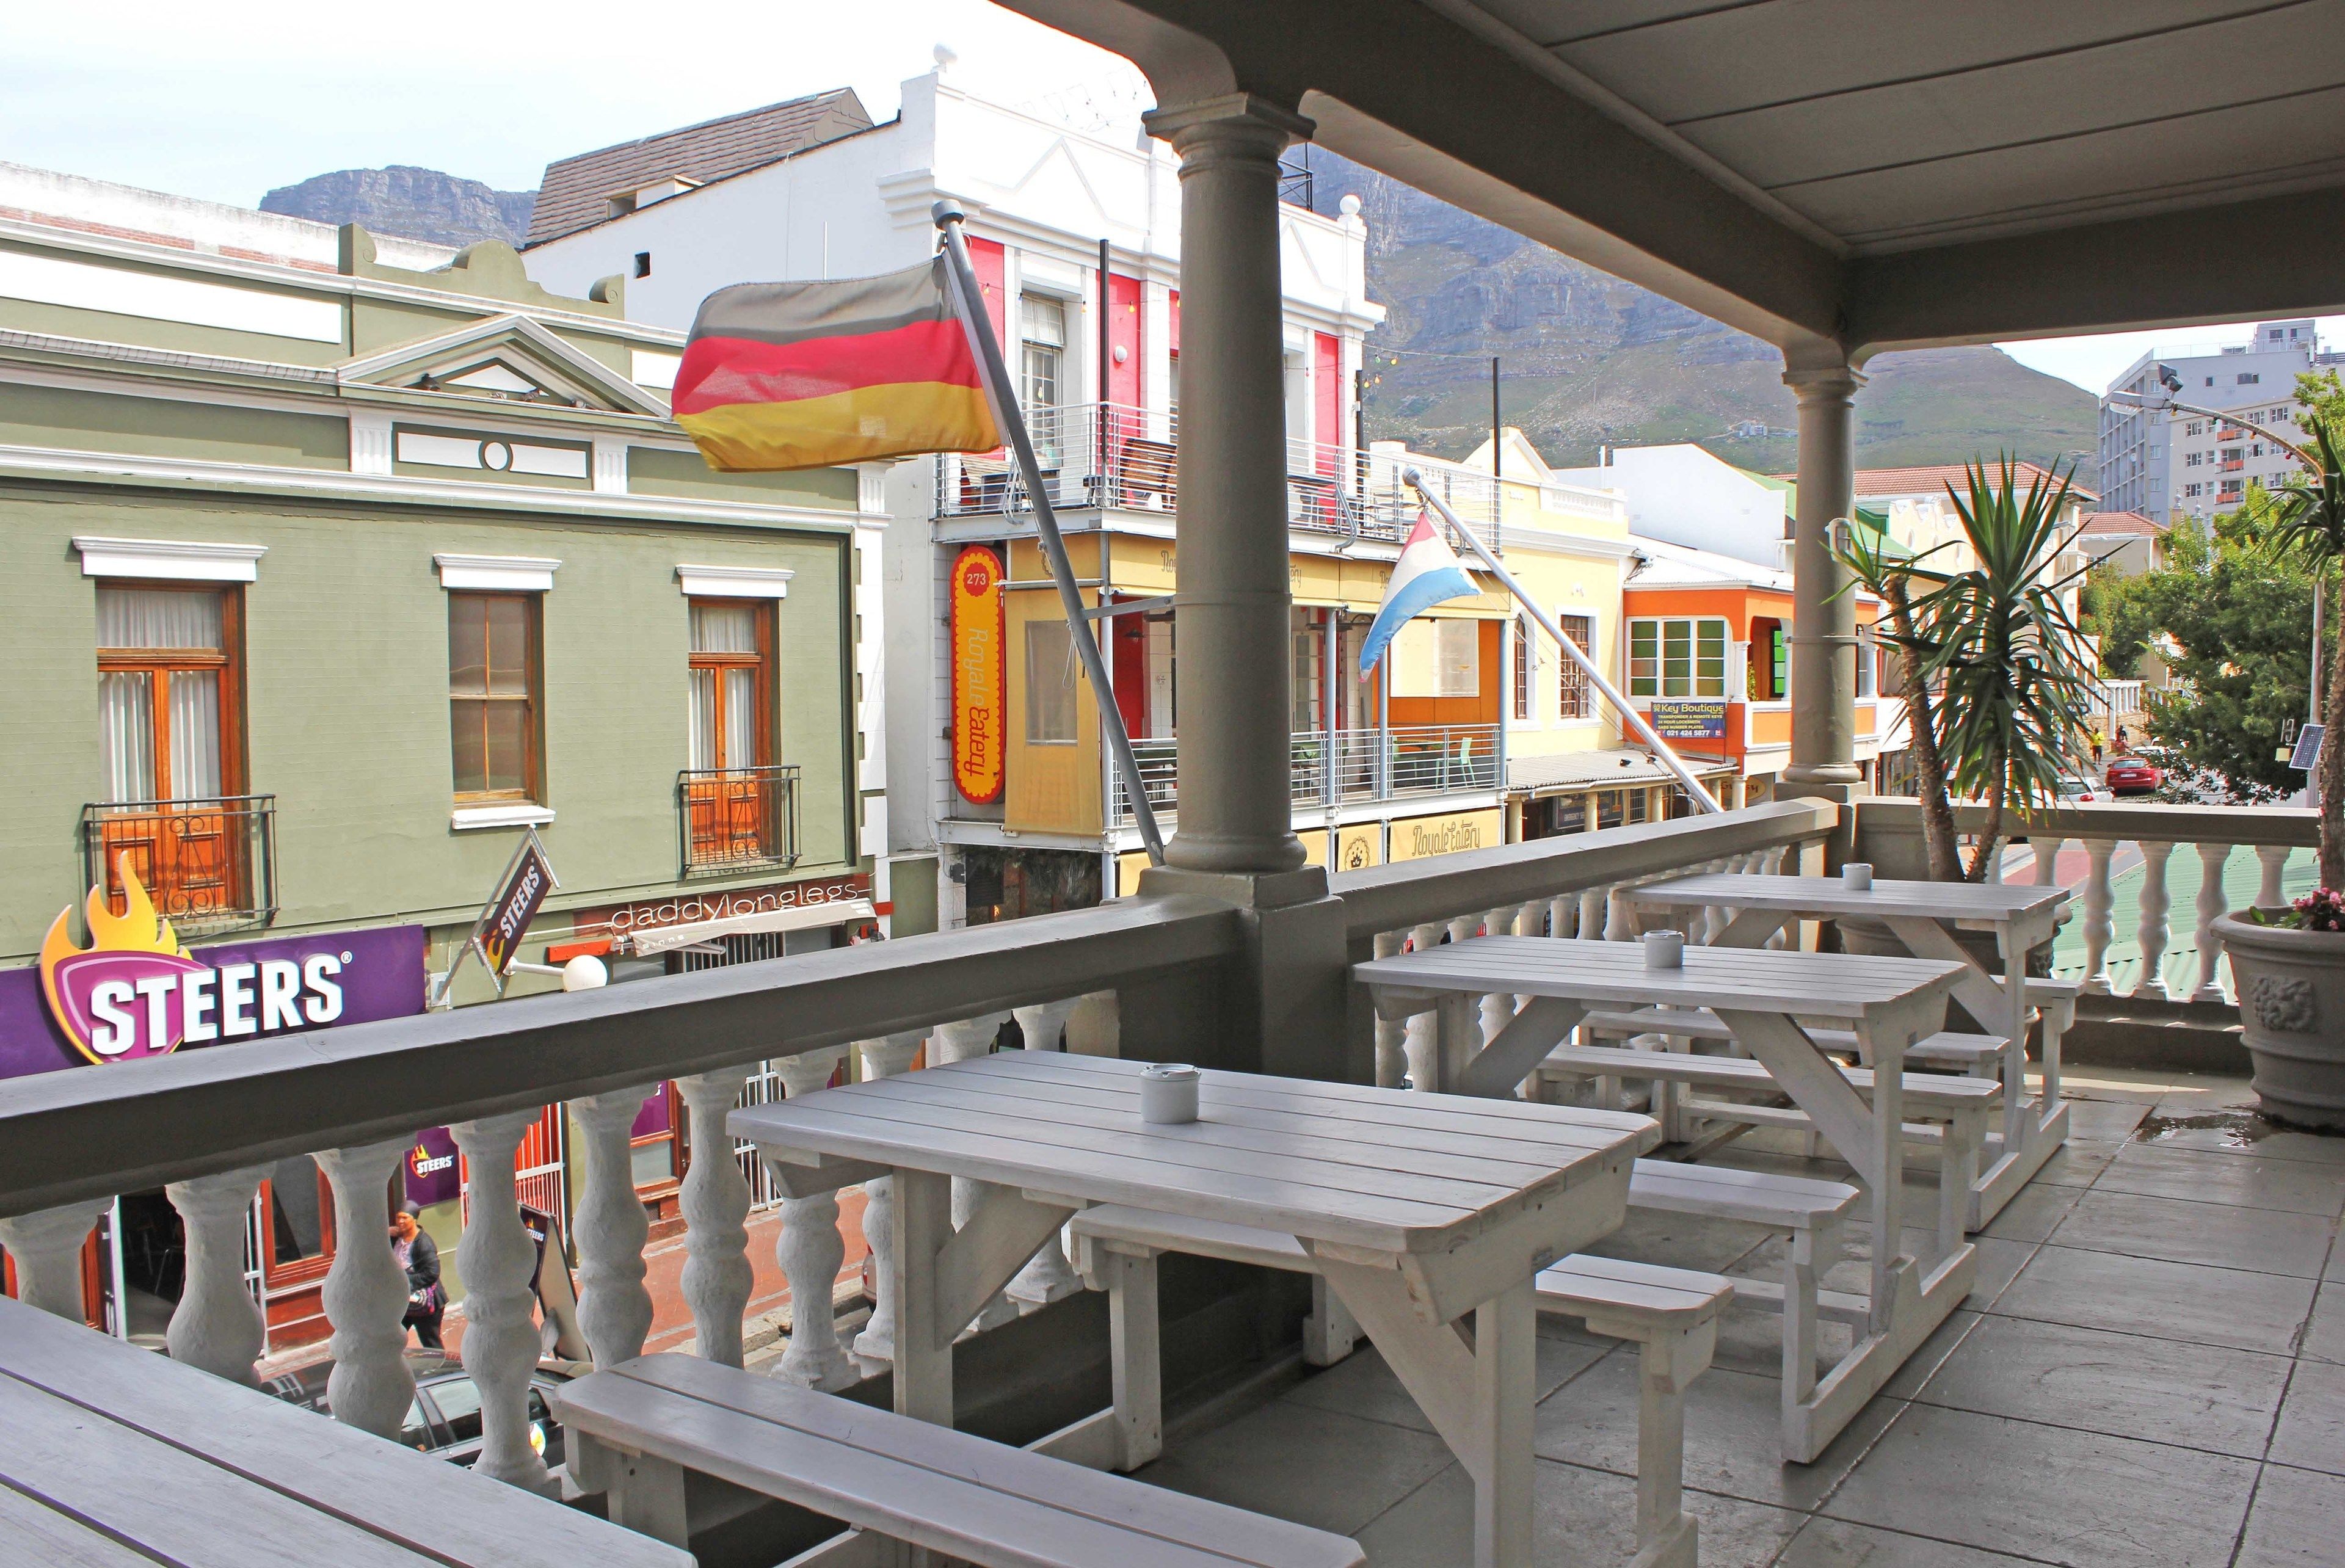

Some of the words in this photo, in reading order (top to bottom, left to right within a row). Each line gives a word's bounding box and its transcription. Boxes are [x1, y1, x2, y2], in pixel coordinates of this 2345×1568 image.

[967, 573, 986, 586] 273
[963, 627, 989, 706] Royale
[1661, 704, 1678, 713] Key
[1681, 703, 1724, 714] Boutique
[964, 706, 990, 777] Eatery
[1412, 822, 1449, 856] Royale
[1447, 819, 1480, 851] Eatery
[500, 865, 540, 939] STEERS
[612, 883, 859, 929] daddylonglegs
[416, 1155, 453, 1174] STEERS
